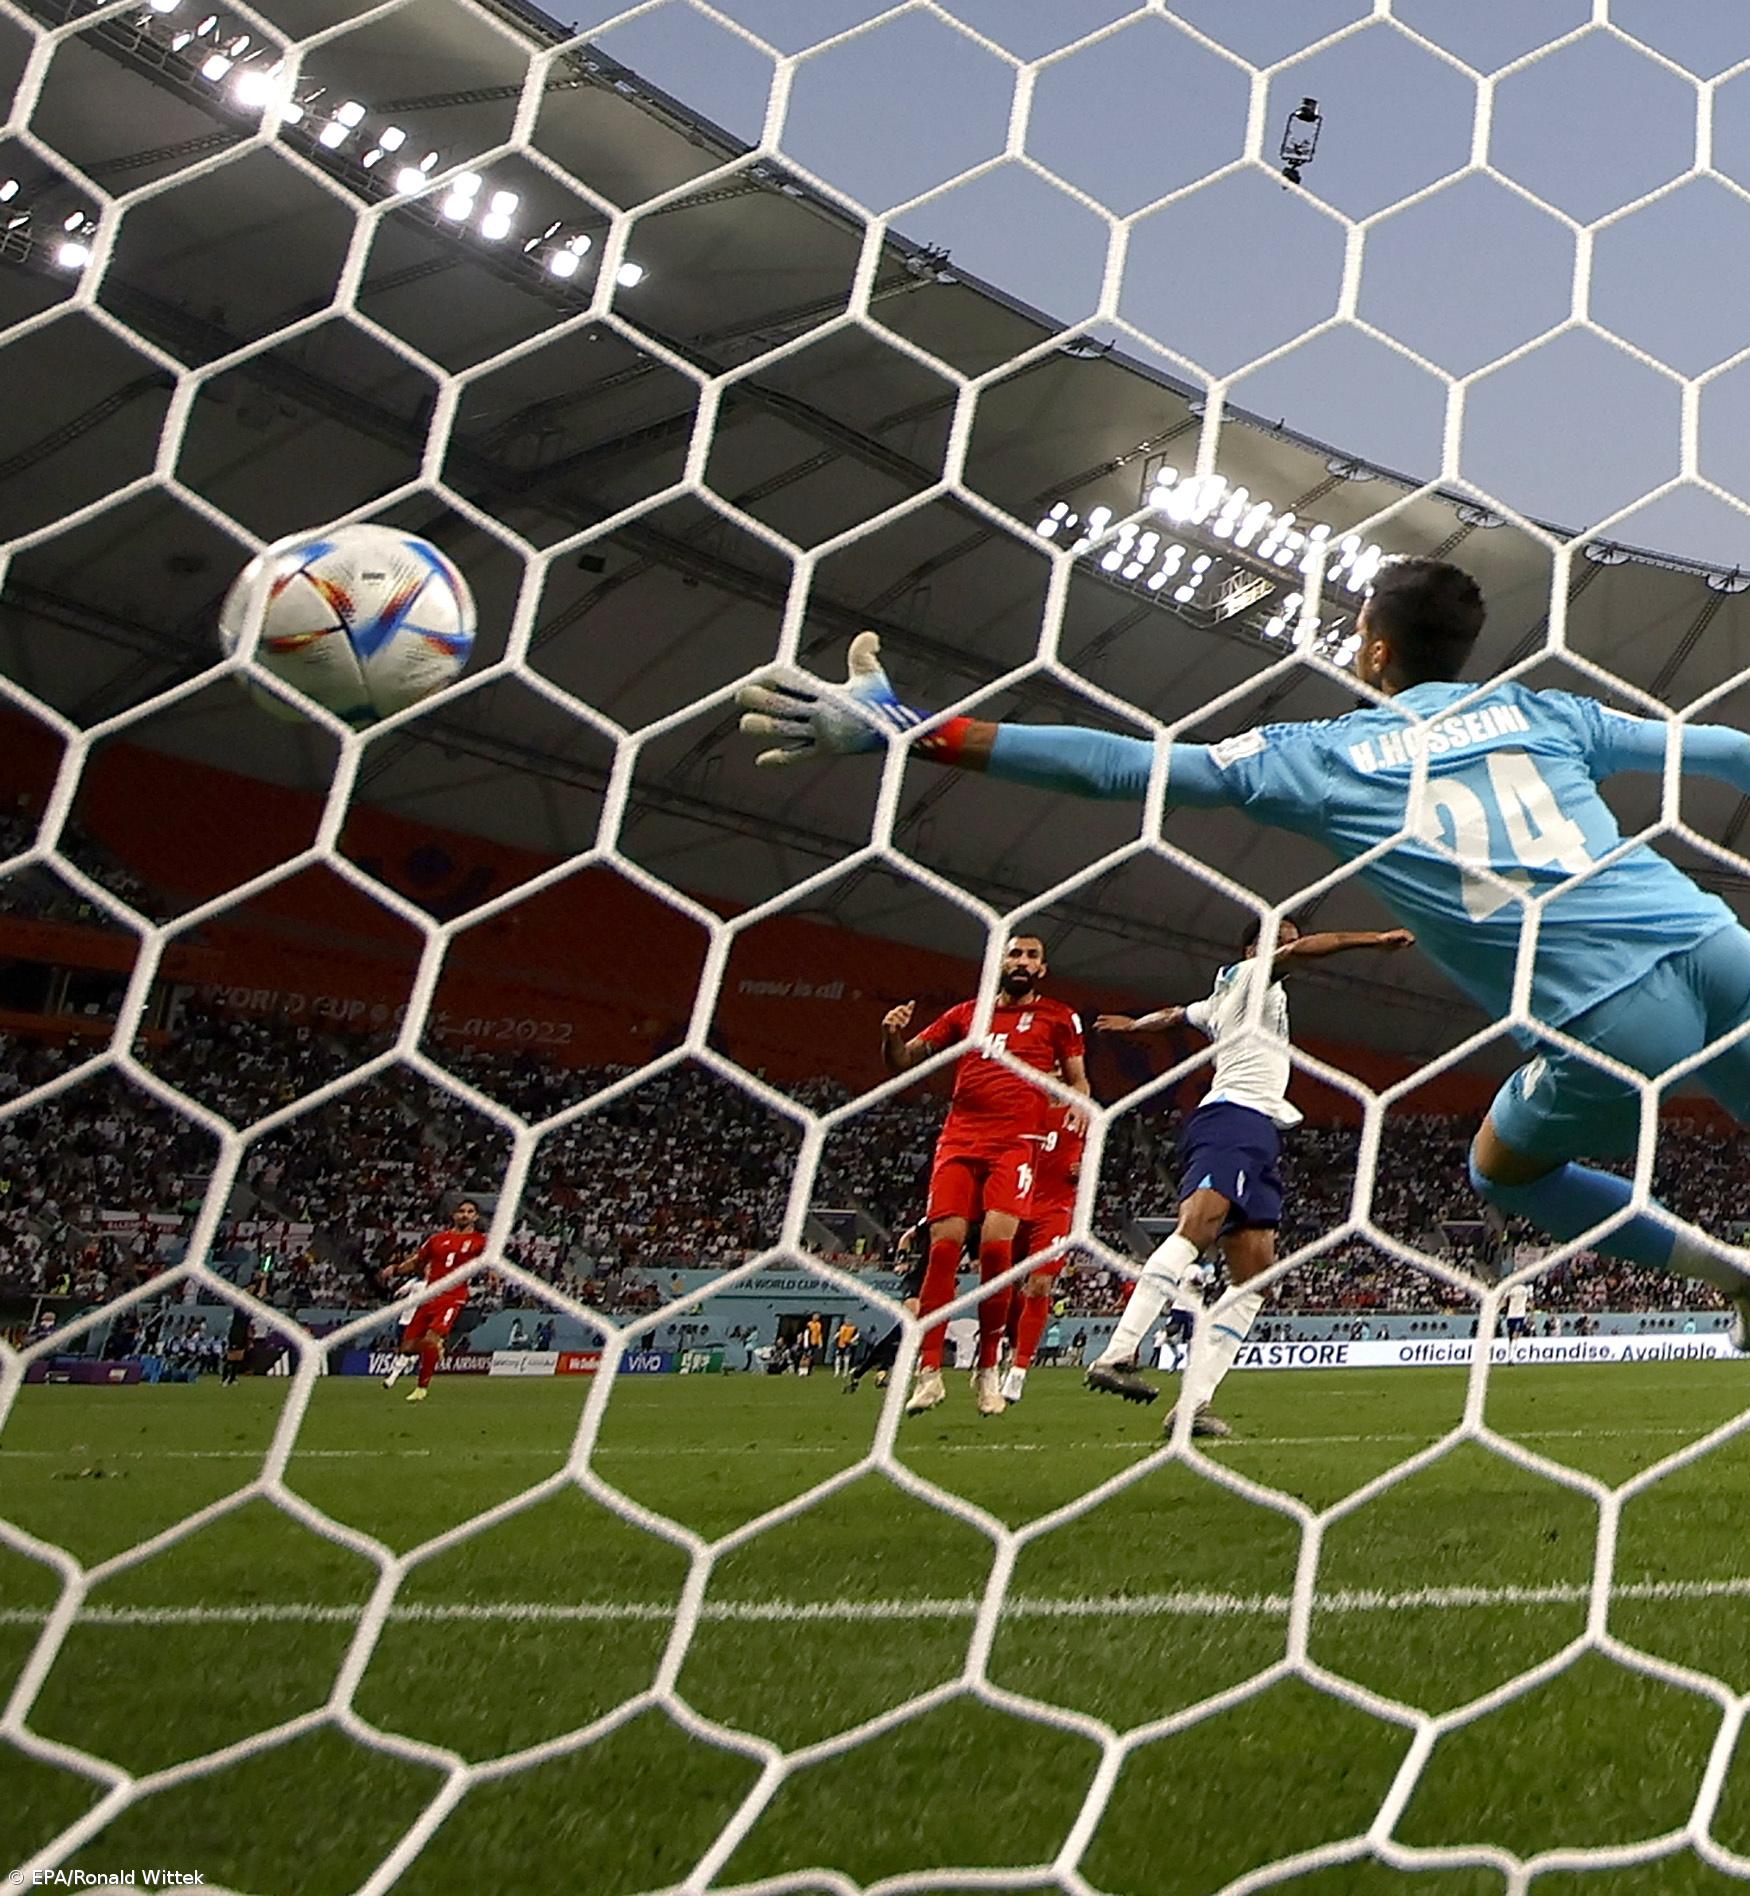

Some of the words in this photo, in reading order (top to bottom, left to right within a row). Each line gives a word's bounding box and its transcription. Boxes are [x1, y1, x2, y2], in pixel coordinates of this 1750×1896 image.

[1414, 751, 1595, 922] 24
[313, 996, 366, 1020] CUP
[1233, 1345, 1263, 1365] FA
[1269, 1344, 1349, 1364] STORE
[1399, 1344, 1472, 1361] Official
[1620, 1342, 1717, 1361] Available
